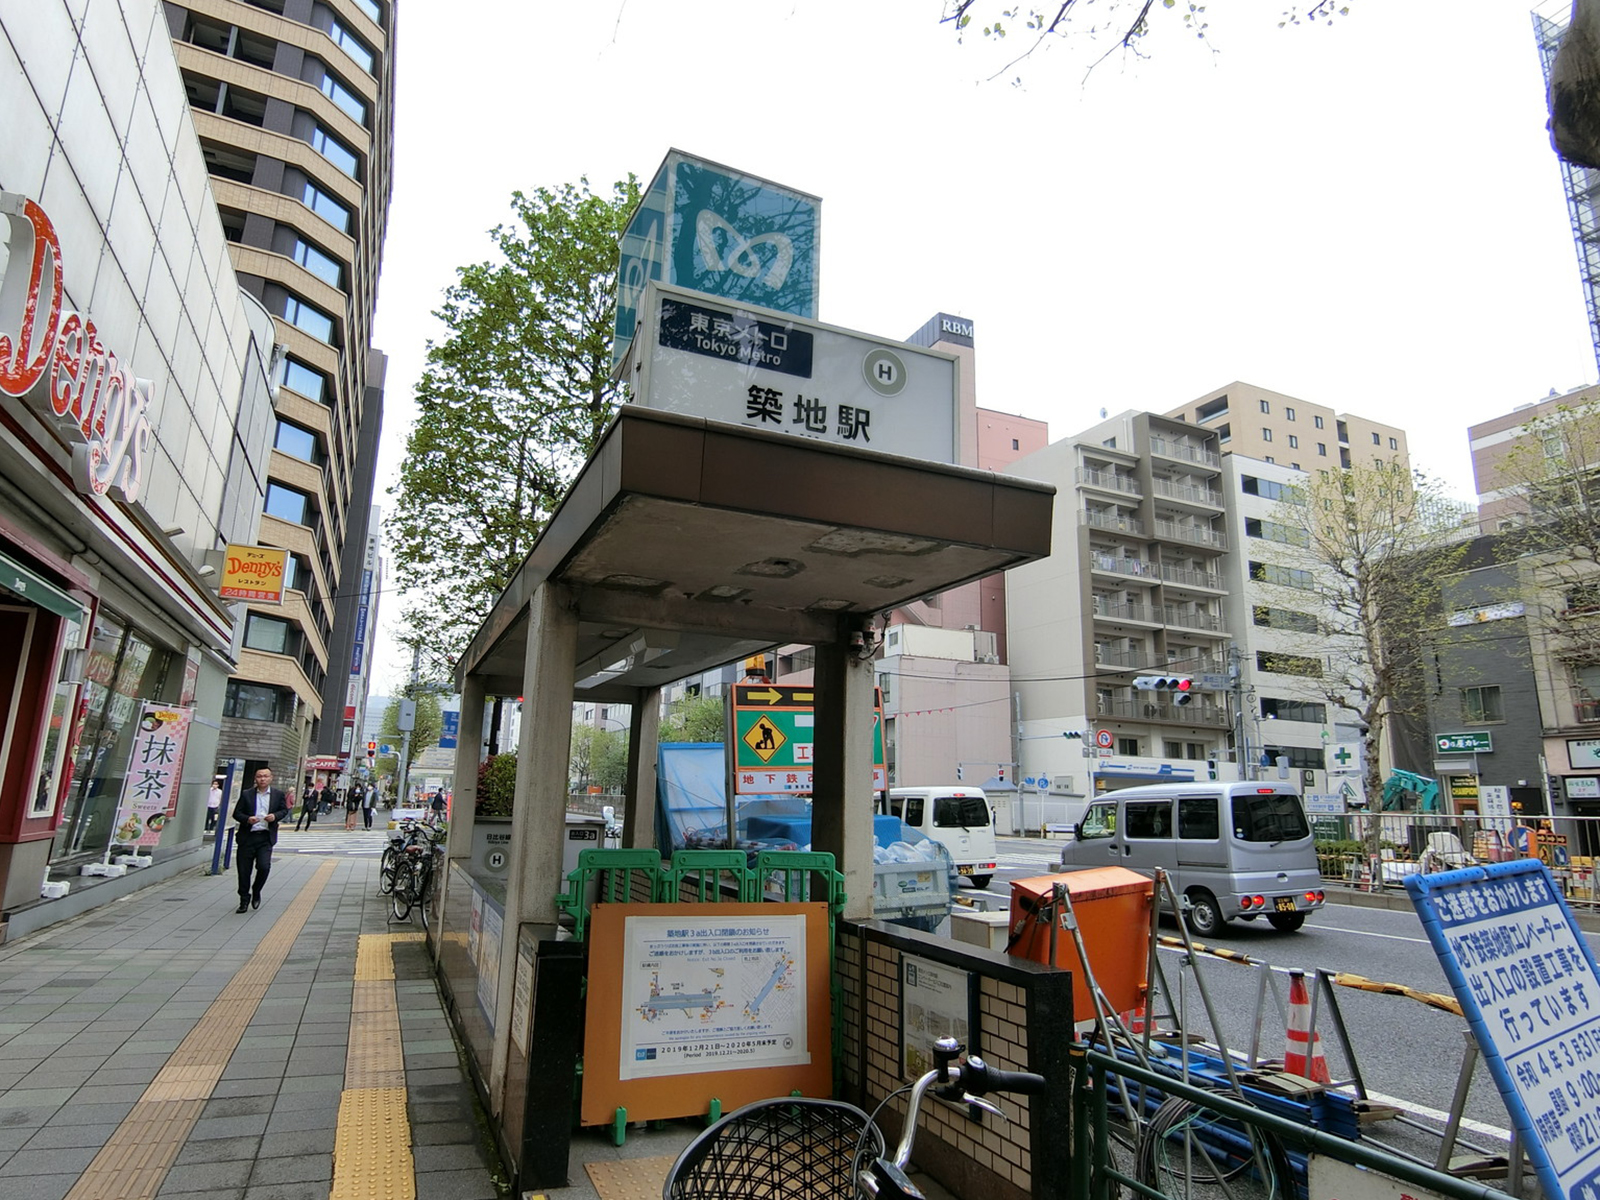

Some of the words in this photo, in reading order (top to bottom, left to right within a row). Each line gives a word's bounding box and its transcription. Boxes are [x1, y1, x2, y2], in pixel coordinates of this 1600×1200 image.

[689, 312, 788, 352] 東京メトロ
[942, 317, 974, 338] RBM
[695, 334, 738, 358] Tokyo
[739, 346, 782, 366] Metro
[877, 363, 893, 381] H
[746, 384, 871, 443] 築地駅
[227, 556, 282, 578] Denny's
[238, 578, 266, 586] レストラン
[225, 588, 275, 600] 24時間営業
[132, 734, 176, 800] 抹茶
[132, 802, 158, 812] Sweets
[584, 830, 595, 839] 3a
[492, 855, 501, 865] H
[1433, 876, 1549, 922] ご迷惑をおかけします
[1469, 944, 1586, 1009] 出入口の設置工事を
[1499, 980, 1590, 1043] 行っています
